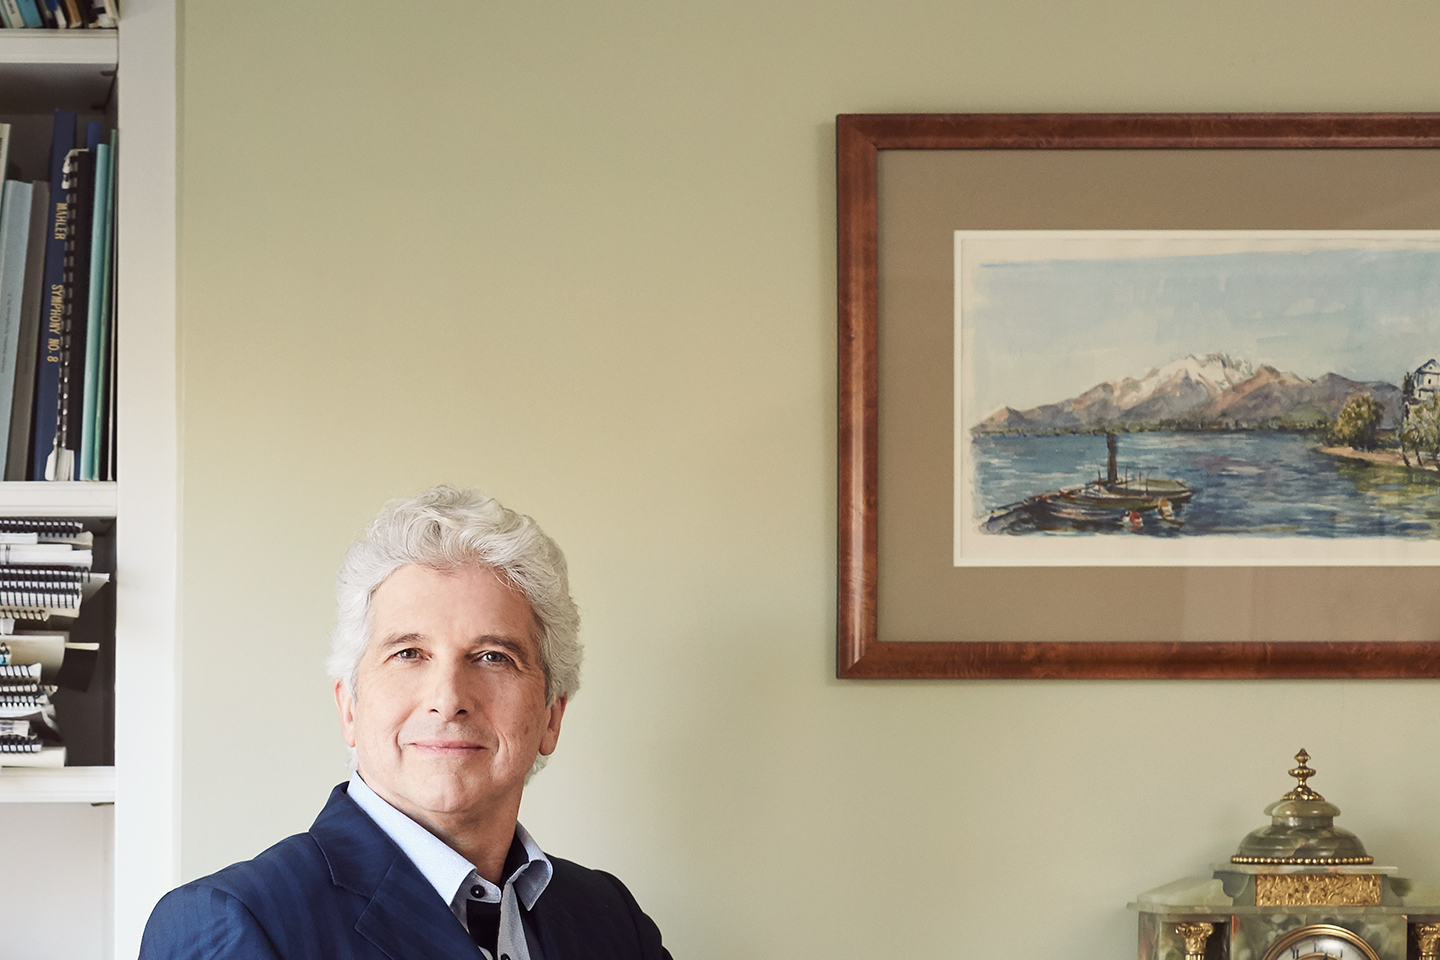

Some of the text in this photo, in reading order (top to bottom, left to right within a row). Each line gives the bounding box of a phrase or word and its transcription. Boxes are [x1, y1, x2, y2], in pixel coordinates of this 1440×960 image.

[54, 203, 68, 240] MAHLER
[48, 284, 63, 334] SYMPHONY
[48, 338, 60, 353] NO.
